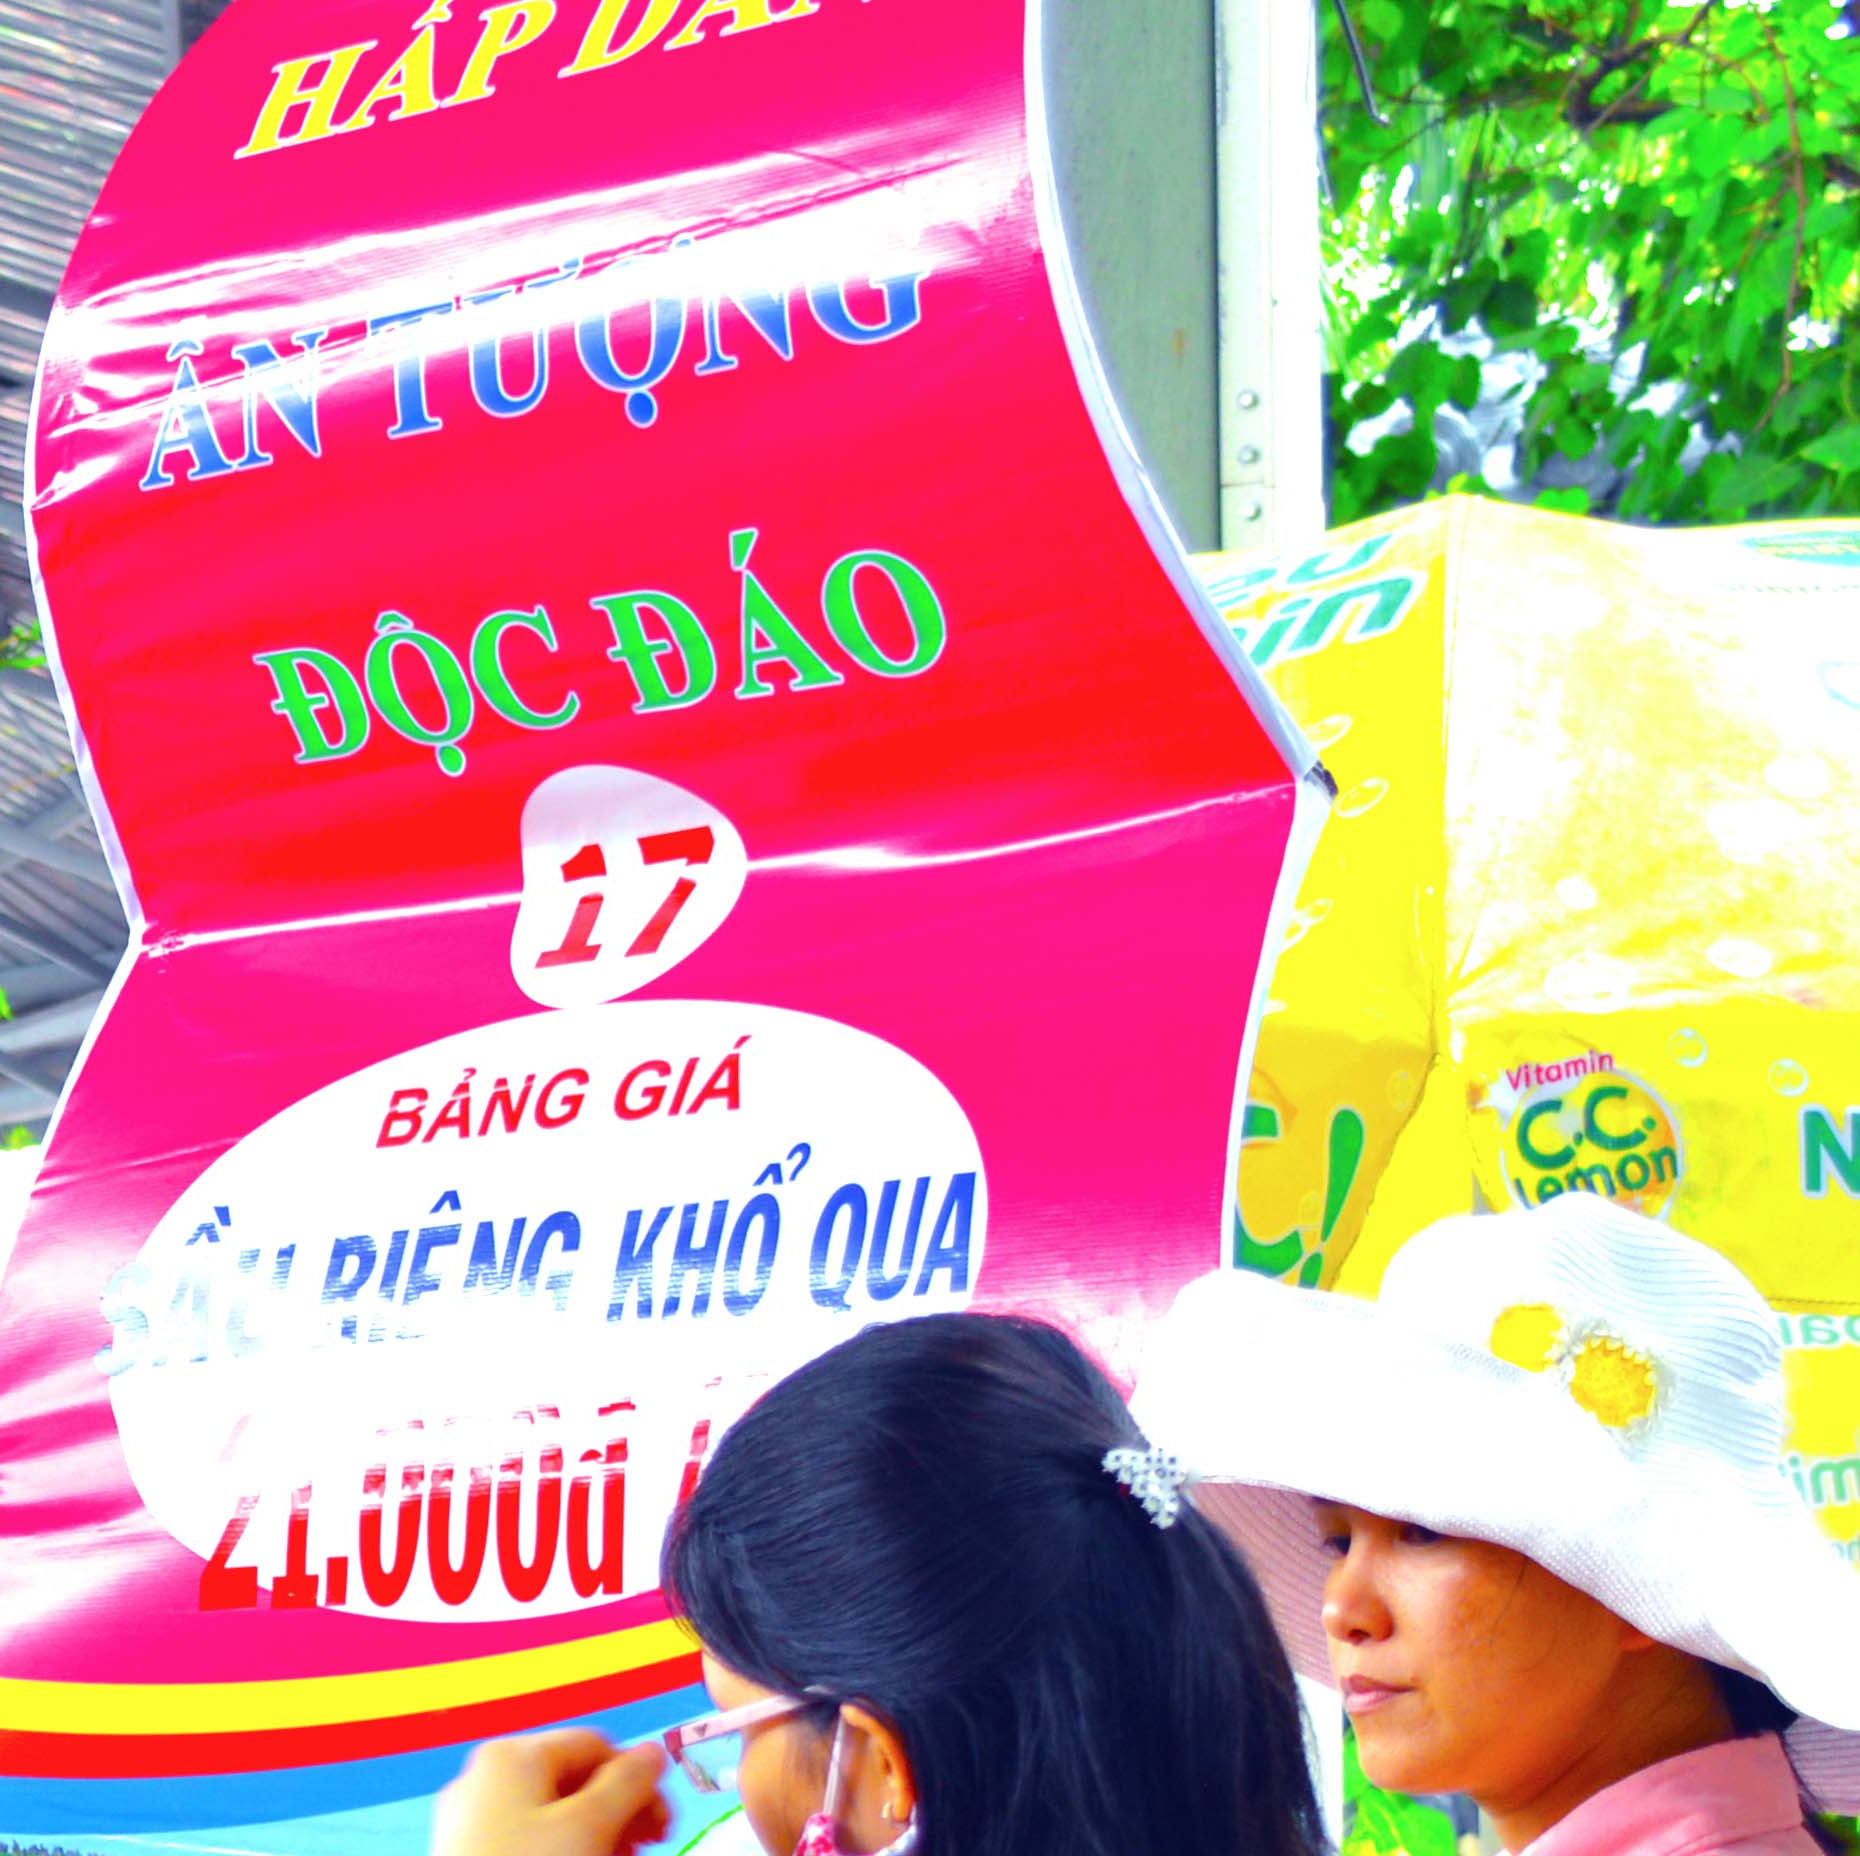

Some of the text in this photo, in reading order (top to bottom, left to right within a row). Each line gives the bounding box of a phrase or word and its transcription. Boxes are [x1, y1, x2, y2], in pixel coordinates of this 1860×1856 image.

[254, 527, 947, 778] ĐỘC ĐÁO
[533, 826, 717, 971] 17
[375, 1034, 753, 1149] BẢNG GIÁ
[1506, 1049, 1614, 1091] Vitamin
[607, 1142, 811, 1322] KHỔ
[810, 1171, 978, 1313] QUA
